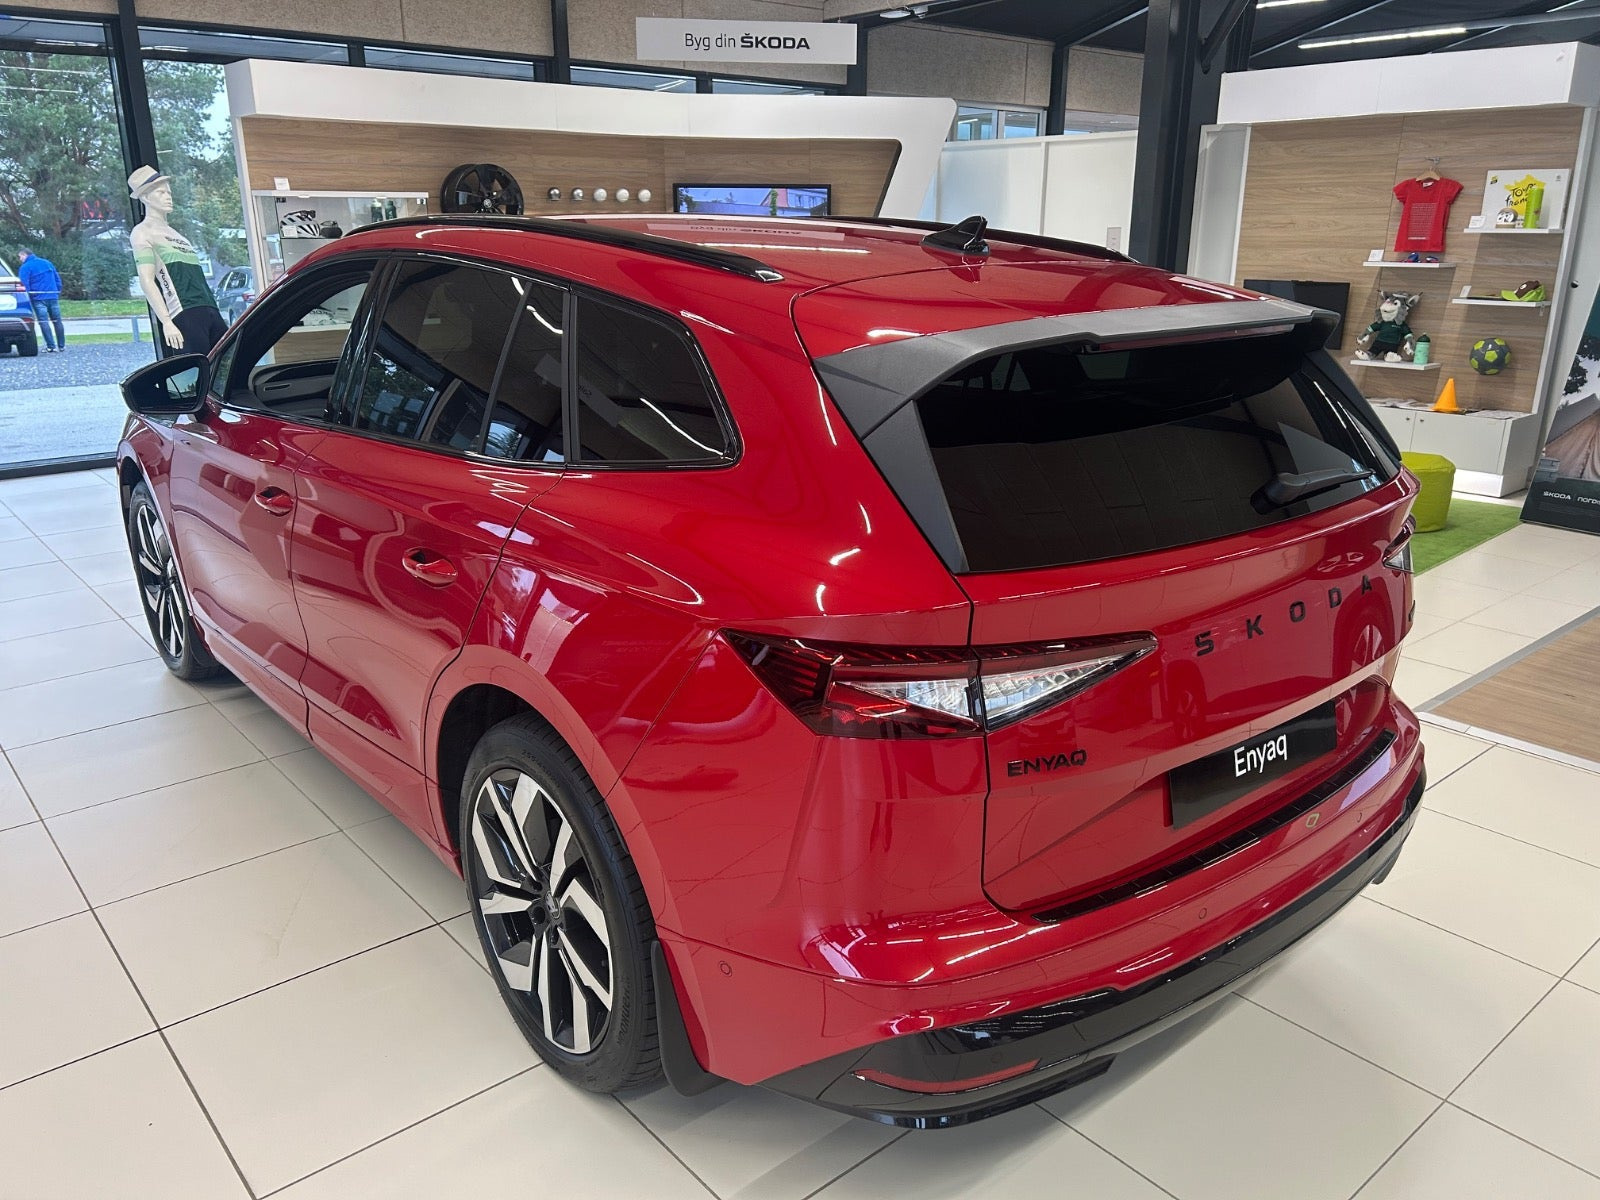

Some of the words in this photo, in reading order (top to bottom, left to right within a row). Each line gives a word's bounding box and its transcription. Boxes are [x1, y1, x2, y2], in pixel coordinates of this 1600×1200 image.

[685, 32, 711, 51] Byg
[715, 32, 736, 48] din
[740, 32, 811, 50] ŠKODA
[1194, 574, 1373, 657] SKODA
[1007, 749, 1087, 777] ENYAQ
[1233, 733, 1288, 778] Enyaq
